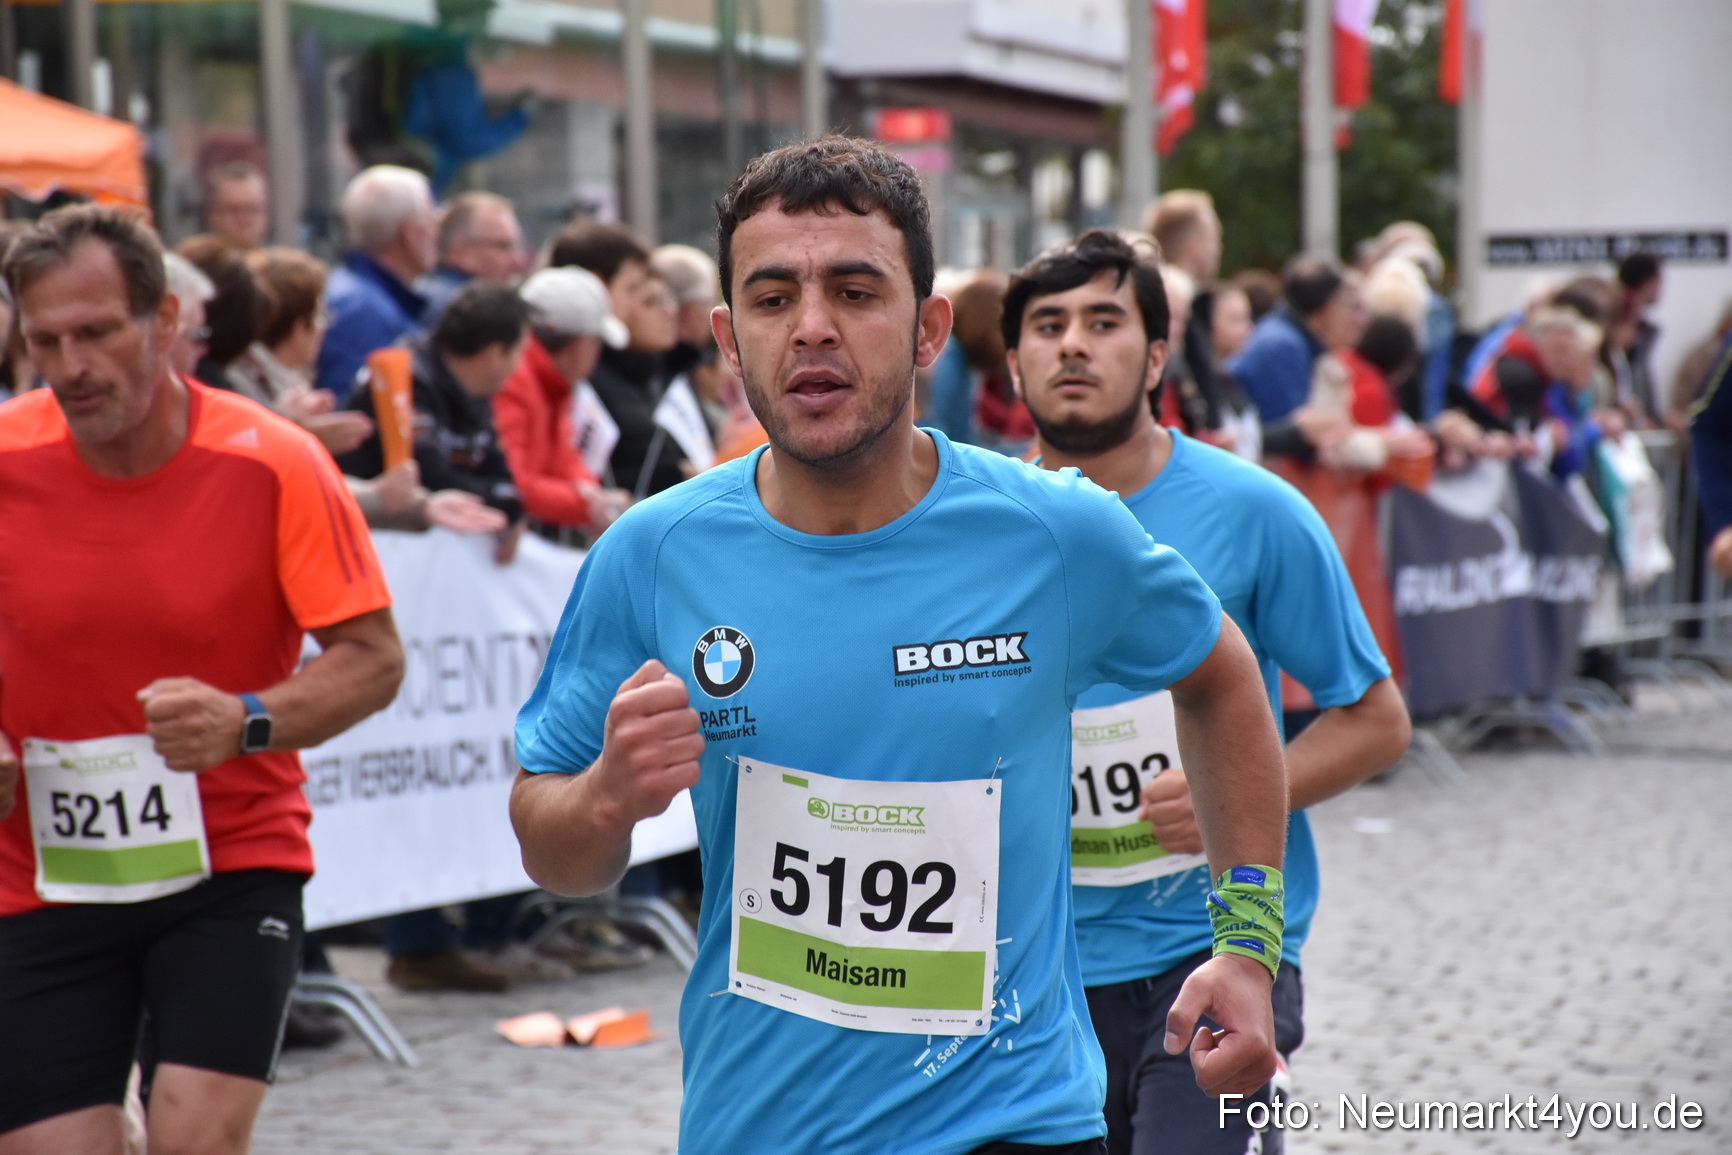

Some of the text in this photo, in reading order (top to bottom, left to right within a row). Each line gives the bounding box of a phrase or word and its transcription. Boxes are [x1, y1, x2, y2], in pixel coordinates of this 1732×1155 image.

[697, 628, 748, 654] BMW
[893, 633, 1029, 675] BOCK
[894, 665, 1032, 688] inspired by smart concepts
[700, 705, 757, 729] PARTL
[704, 724, 757, 742] Neumarkt
[51, 784, 171, 839] 5214
[831, 803, 925, 827] BOCK
[831, 823, 859, 832] inspired
[860, 825, 870, 833] by
[893, 827, 926, 835] concepts
[770, 841, 957, 934] 5192
[805, 947, 907, 989] Maisam
[923, 1062, 941, 1078] 17.
